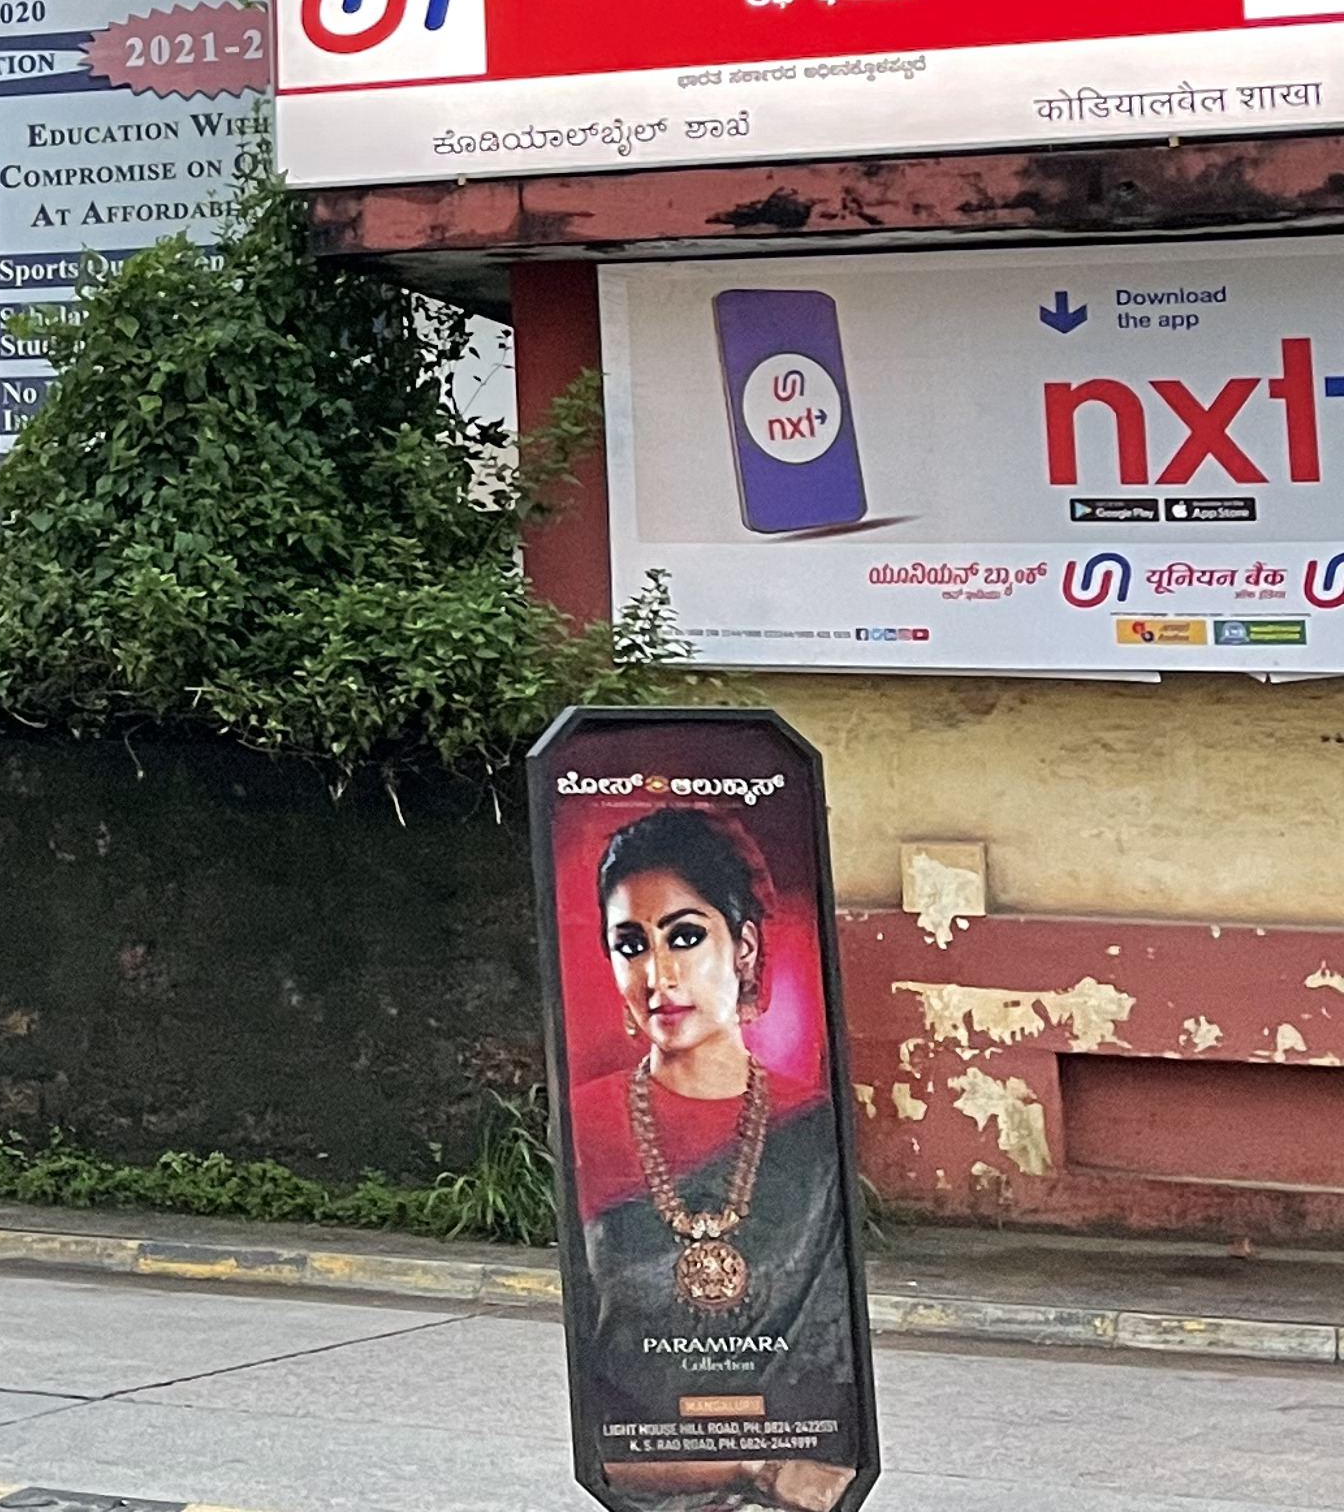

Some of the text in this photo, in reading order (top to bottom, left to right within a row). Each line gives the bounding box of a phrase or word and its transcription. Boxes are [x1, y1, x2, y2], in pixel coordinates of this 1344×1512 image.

[1236, 82, 1322, 109] शाखा
[26, 120, 180, 148] EDUCATION
[0, 160, 222, 189] COMPROMISE ON
[30, 203, 72, 228] AT
[1116, 286, 1227, 306] Download
[1117, 313, 1199, 330] the app
[1095, 508, 1155, 520] Google Play
[1192, 508, 1250, 520] App Store
[1146, 560, 1287, 595] यूनियन बैंक
[643, 1336, 789, 1353] PARAMPARA
[682, 1357, 755, 1372] Collection
[603, 1424, 637, 1436] LIGHT
[638, 1423, 677, 1435] HOUSE
[680, 1423, 705, 1434] HILL
